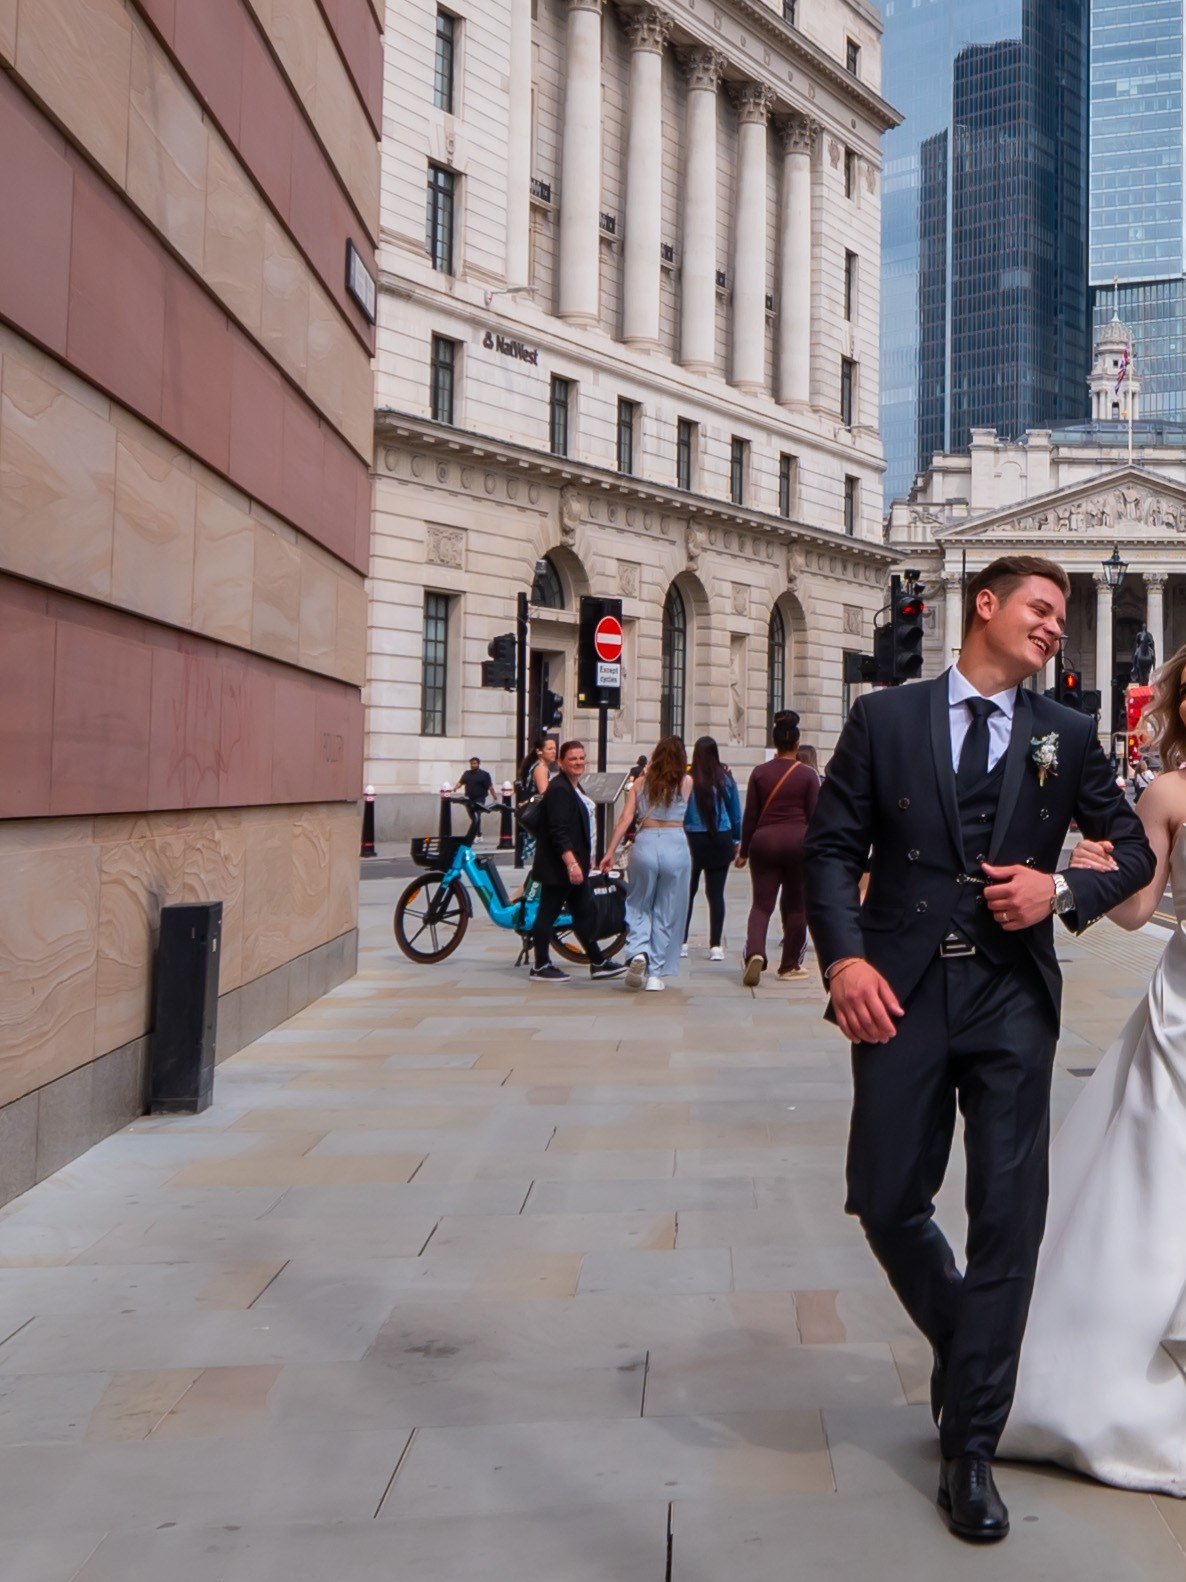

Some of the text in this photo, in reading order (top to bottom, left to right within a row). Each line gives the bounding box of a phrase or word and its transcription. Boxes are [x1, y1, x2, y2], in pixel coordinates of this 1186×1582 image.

[496, 334, 538, 366] NatWest
[600, 665, 618, 675] Except
[600, 676, 618, 684] cycles
